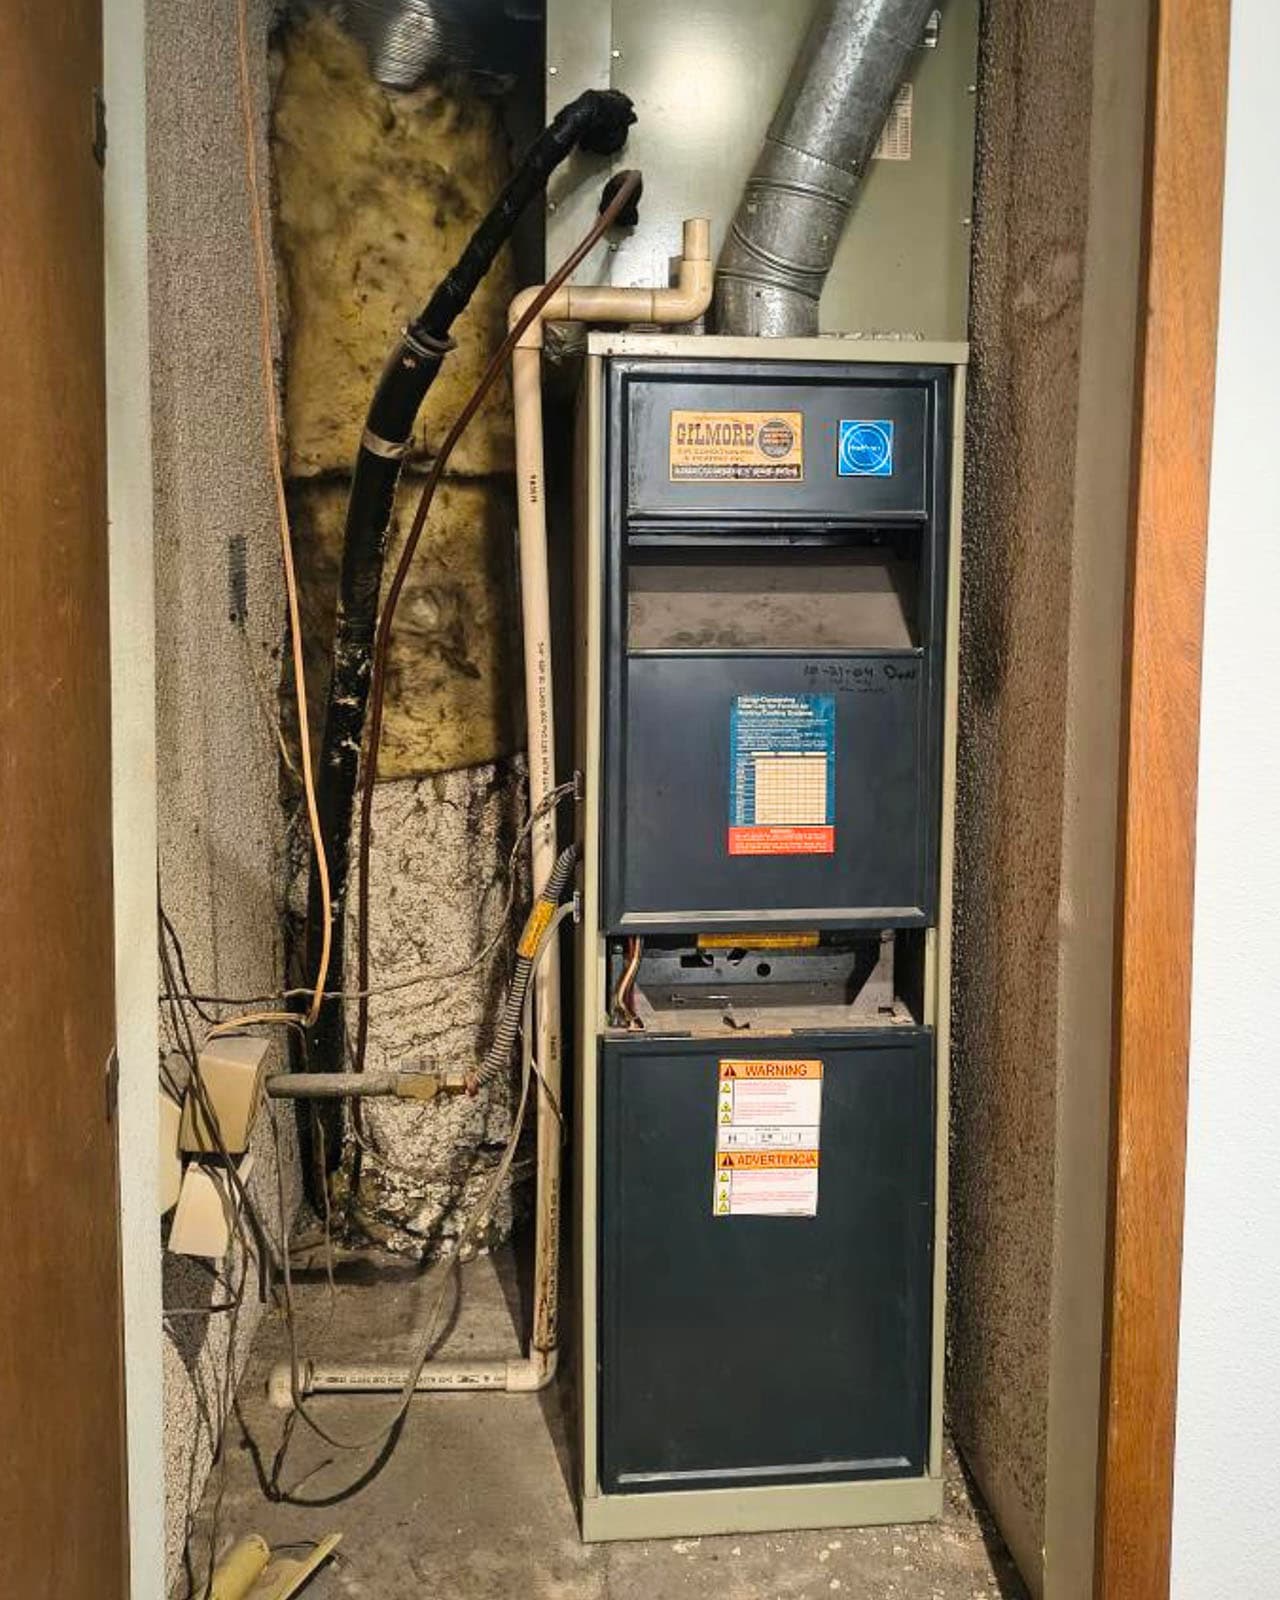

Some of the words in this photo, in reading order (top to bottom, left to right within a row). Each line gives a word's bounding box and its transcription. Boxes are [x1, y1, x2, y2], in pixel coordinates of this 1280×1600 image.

[676, 422, 756, 447] GILMORE
[745, 1063, 808, 1077] WARNING
[737, 1153, 817, 1166] ADVERTENCIA
